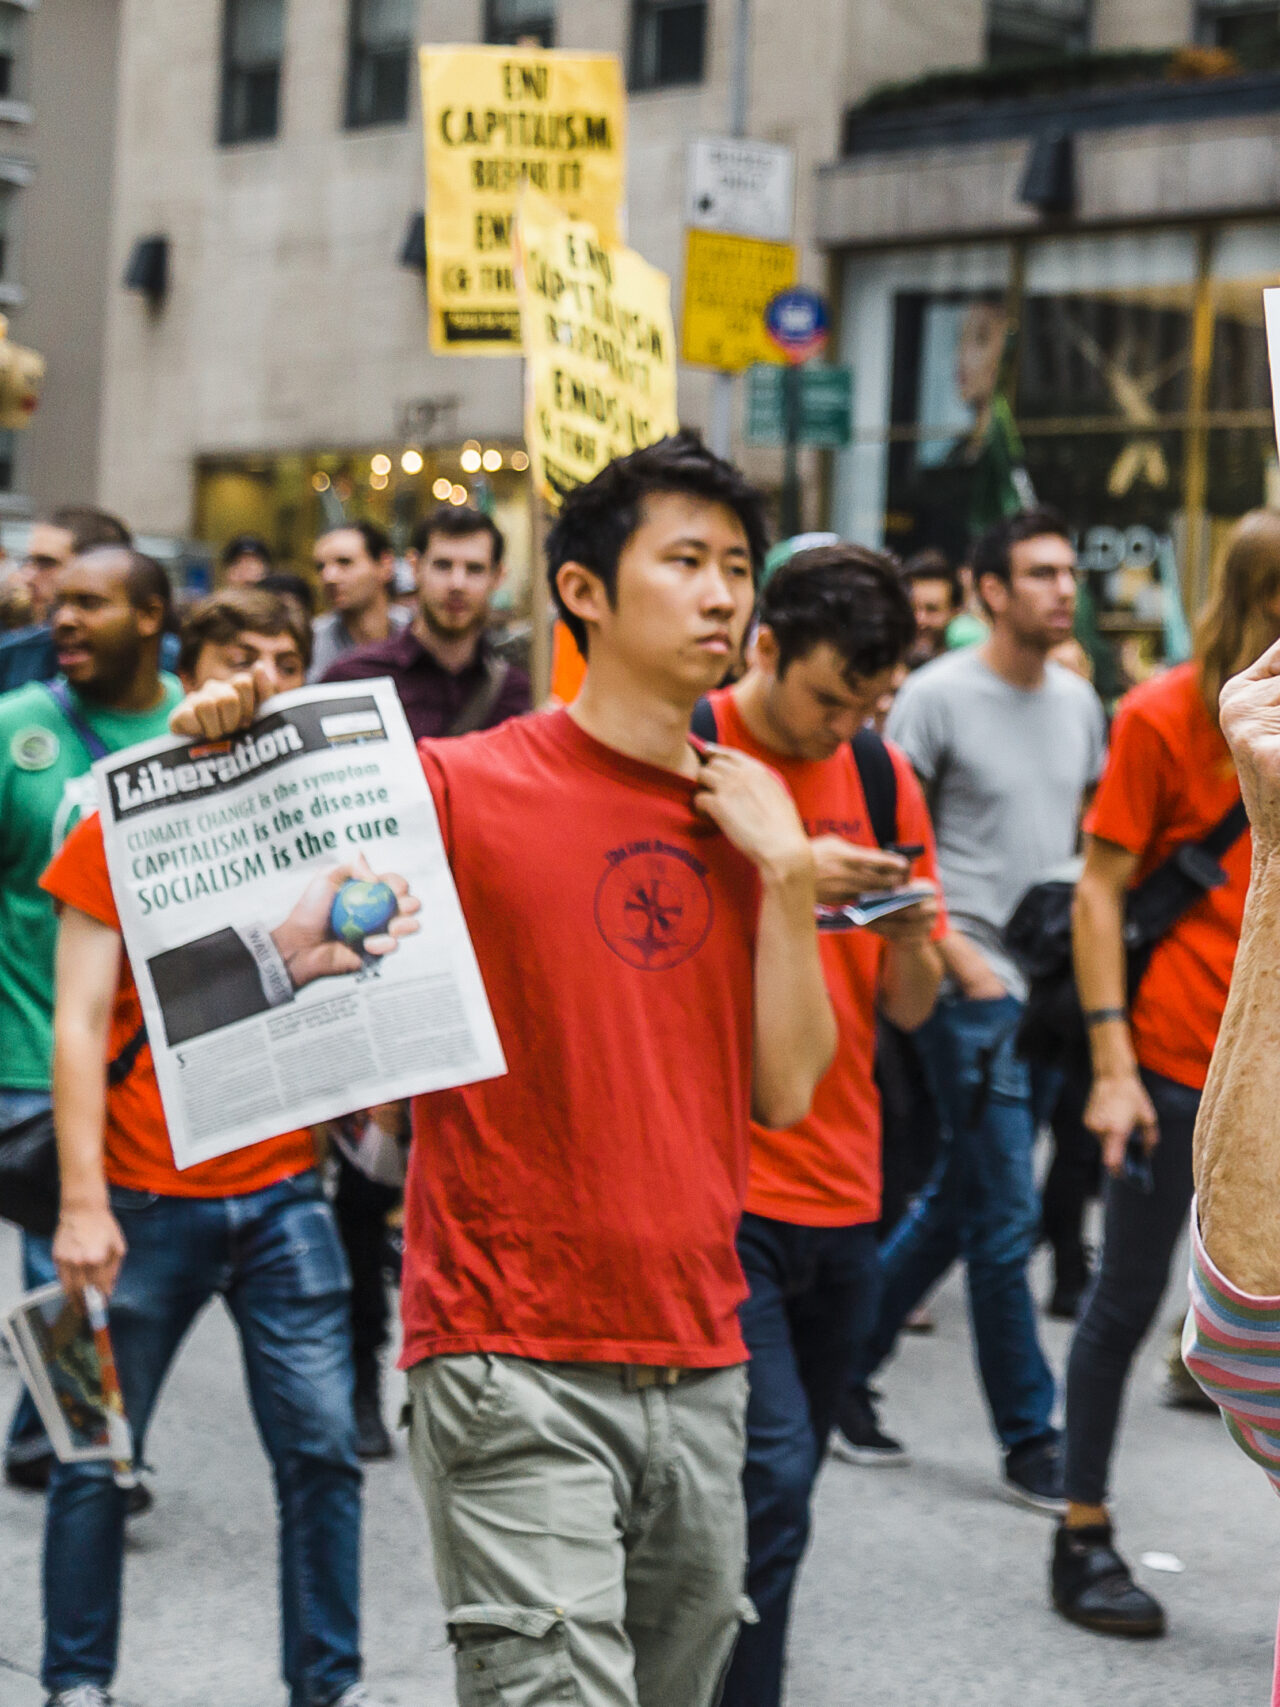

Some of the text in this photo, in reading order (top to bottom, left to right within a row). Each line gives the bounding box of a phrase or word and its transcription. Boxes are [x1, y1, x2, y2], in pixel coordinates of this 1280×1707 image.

[441, 108, 612, 150] CAPITALISM
[114, 724, 303, 811] Liberation
[127, 763, 381, 853] CLIMATE CHANGE is the symptom
[132, 786, 389, 881] CAPITALISM is the disease
[138, 815, 400, 916] SOCIALISM is the cure
